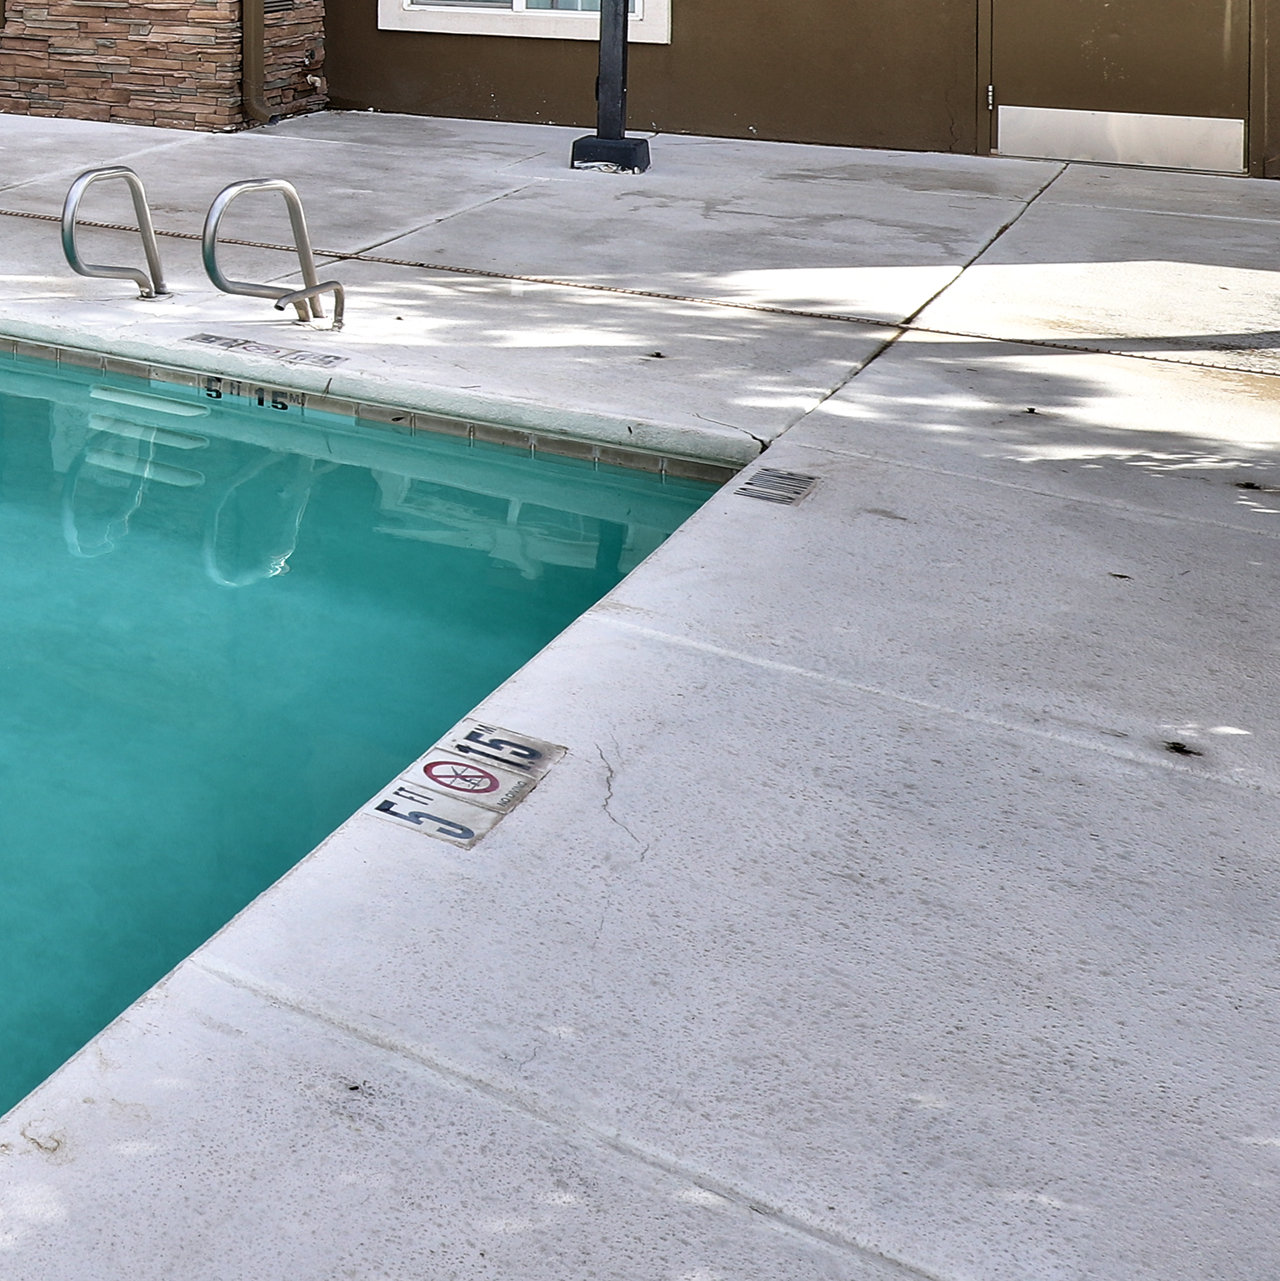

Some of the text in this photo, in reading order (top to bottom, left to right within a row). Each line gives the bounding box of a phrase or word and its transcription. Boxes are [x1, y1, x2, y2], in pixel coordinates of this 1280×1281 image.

[205, 376, 223, 400] 5
[454, 723, 542, 771] 1.5 M
[497, 780, 528, 807] NO DIVING
[374, 786, 475, 840] 5 FT
